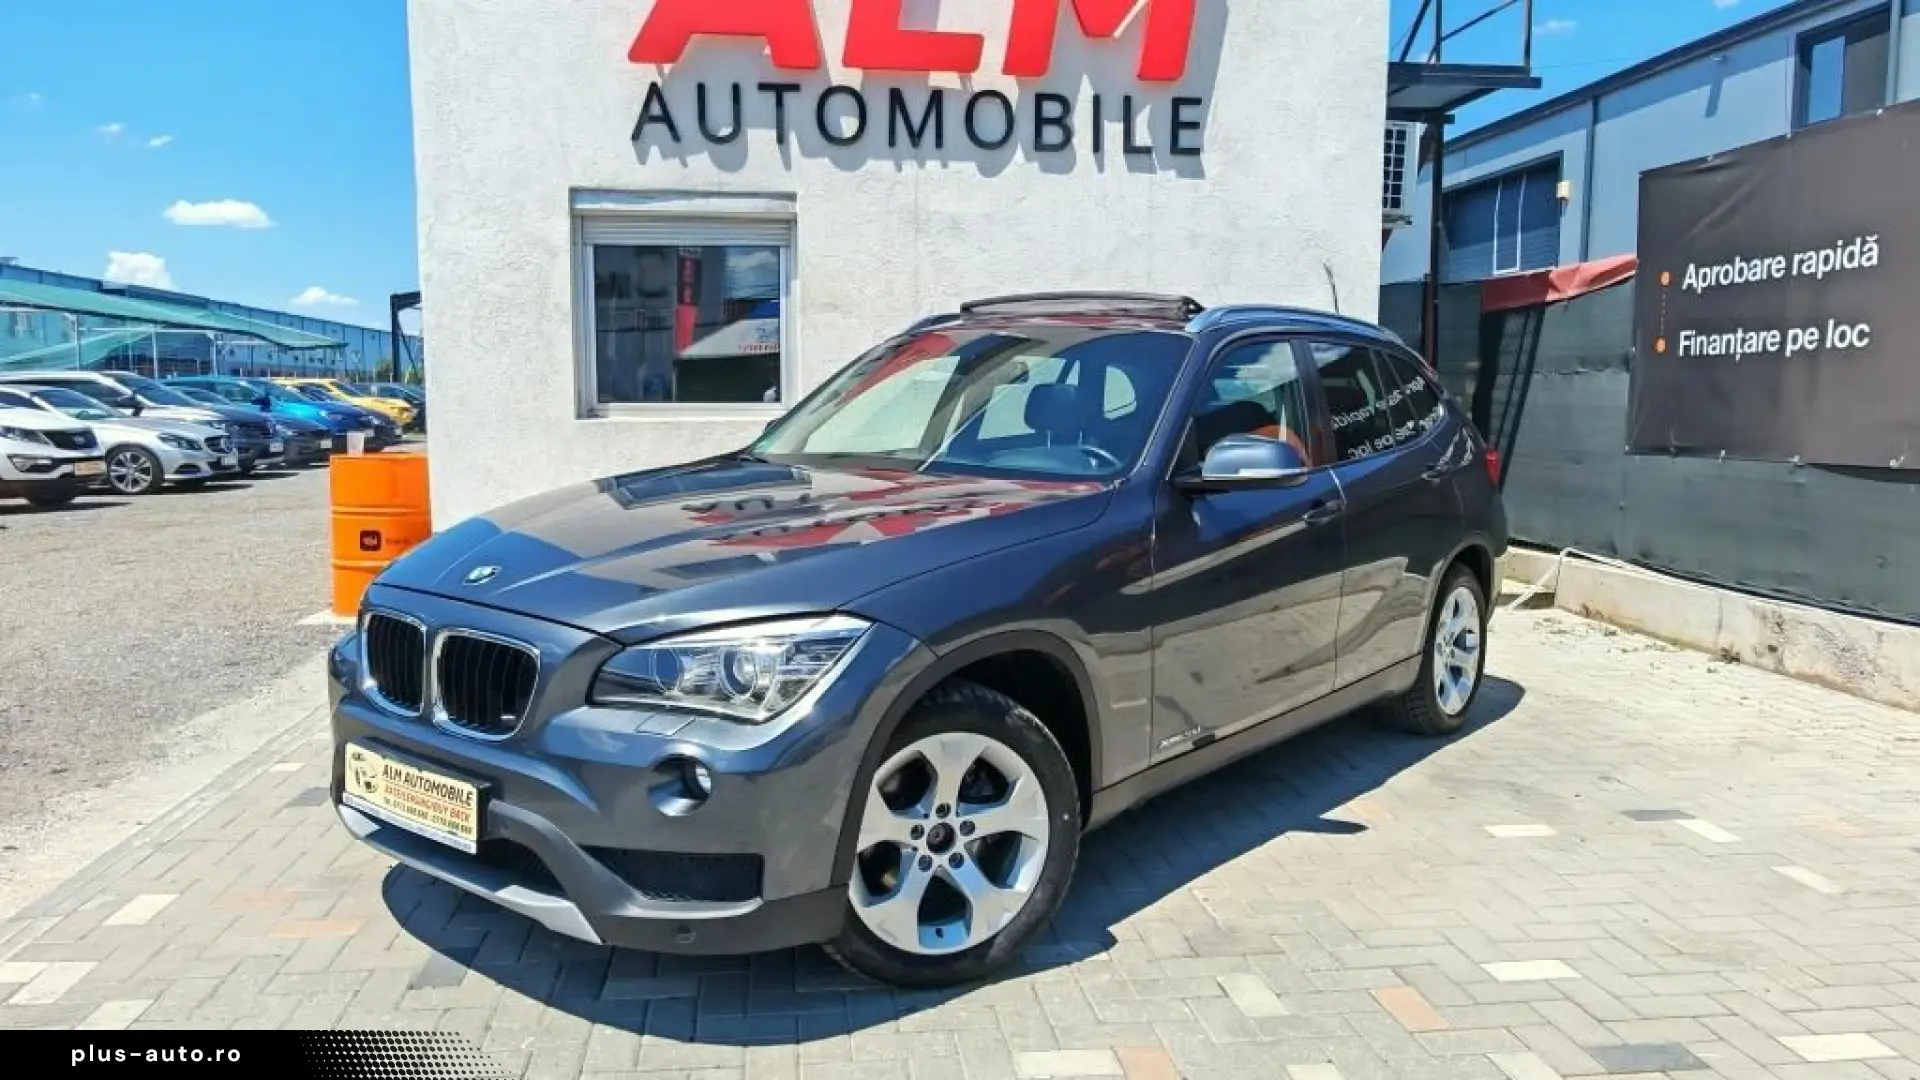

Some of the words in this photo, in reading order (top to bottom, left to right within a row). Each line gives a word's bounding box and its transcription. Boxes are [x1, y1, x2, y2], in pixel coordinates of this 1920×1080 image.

[631, 80, 1203, 157] AUTOMOBILE
[1681, 254, 1786, 294] Aprobare
[1791, 234, 1880, 280] rapidă
[1678, 327, 1781, 363] Finanțare
[1785, 326, 1819, 358] pe
[1825, 318, 1871, 350] loc
[382, 764, 402, 781] ALM
[404, 770, 473, 807] AUTOMOBILE
